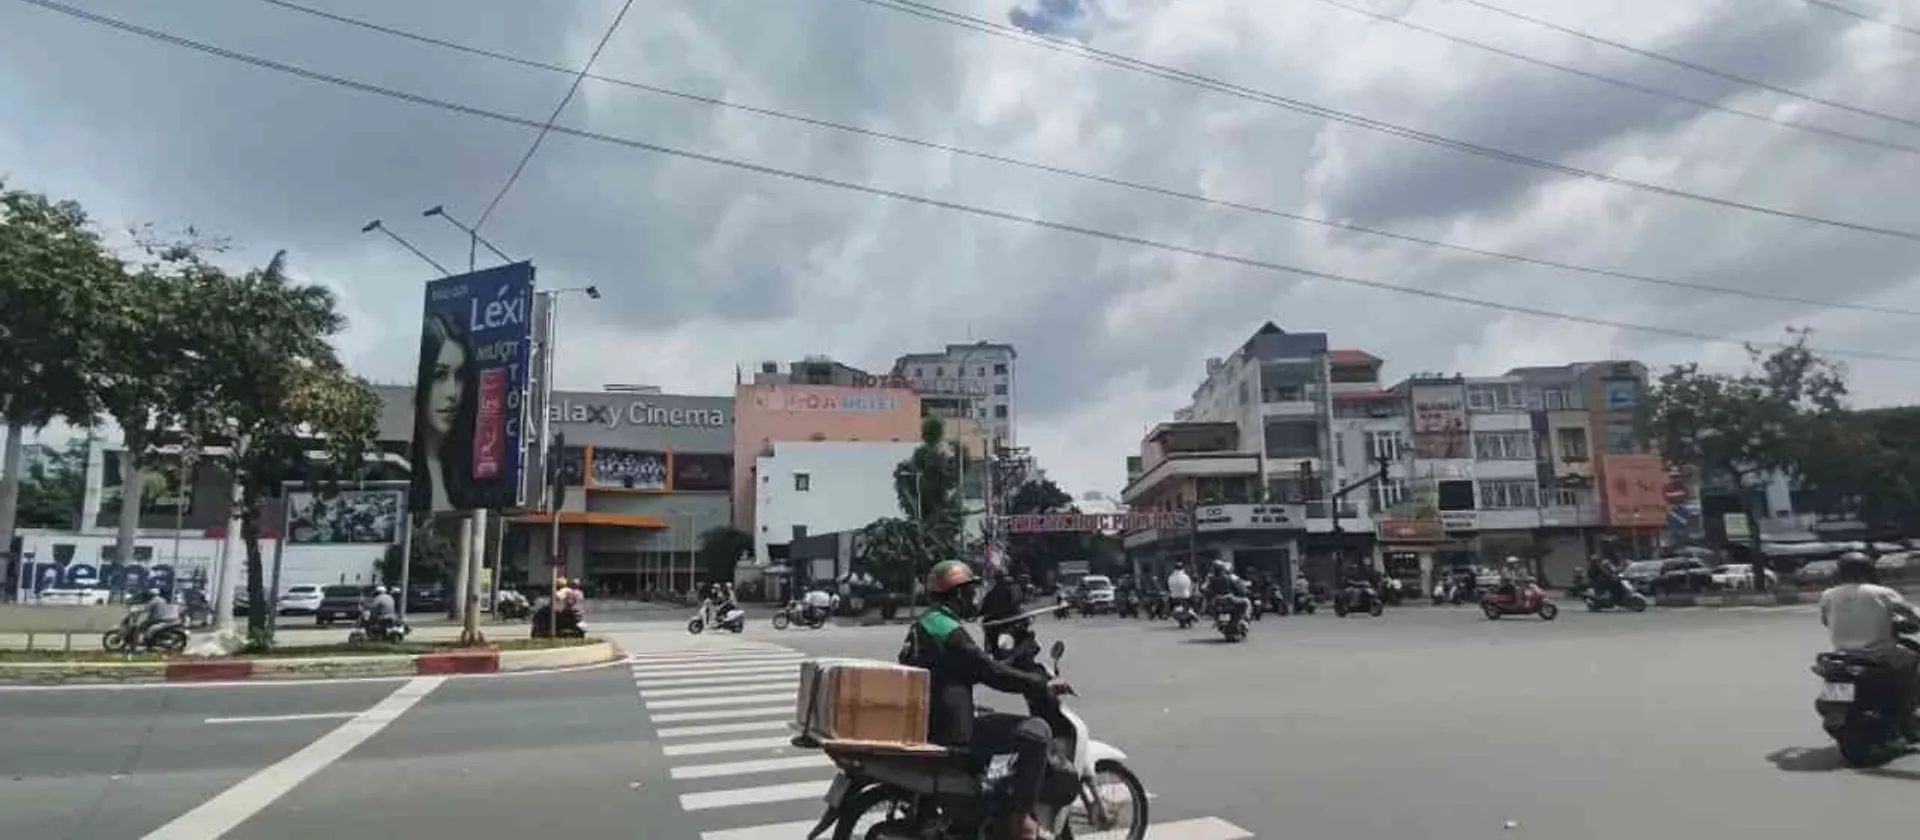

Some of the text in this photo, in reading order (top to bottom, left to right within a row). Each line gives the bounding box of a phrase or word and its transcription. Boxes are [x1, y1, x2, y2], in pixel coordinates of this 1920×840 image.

[469, 283, 525, 332] Léxi
[548, 399, 724, 429] alaxy Cinema
[22, 552, 175, 600] inema
